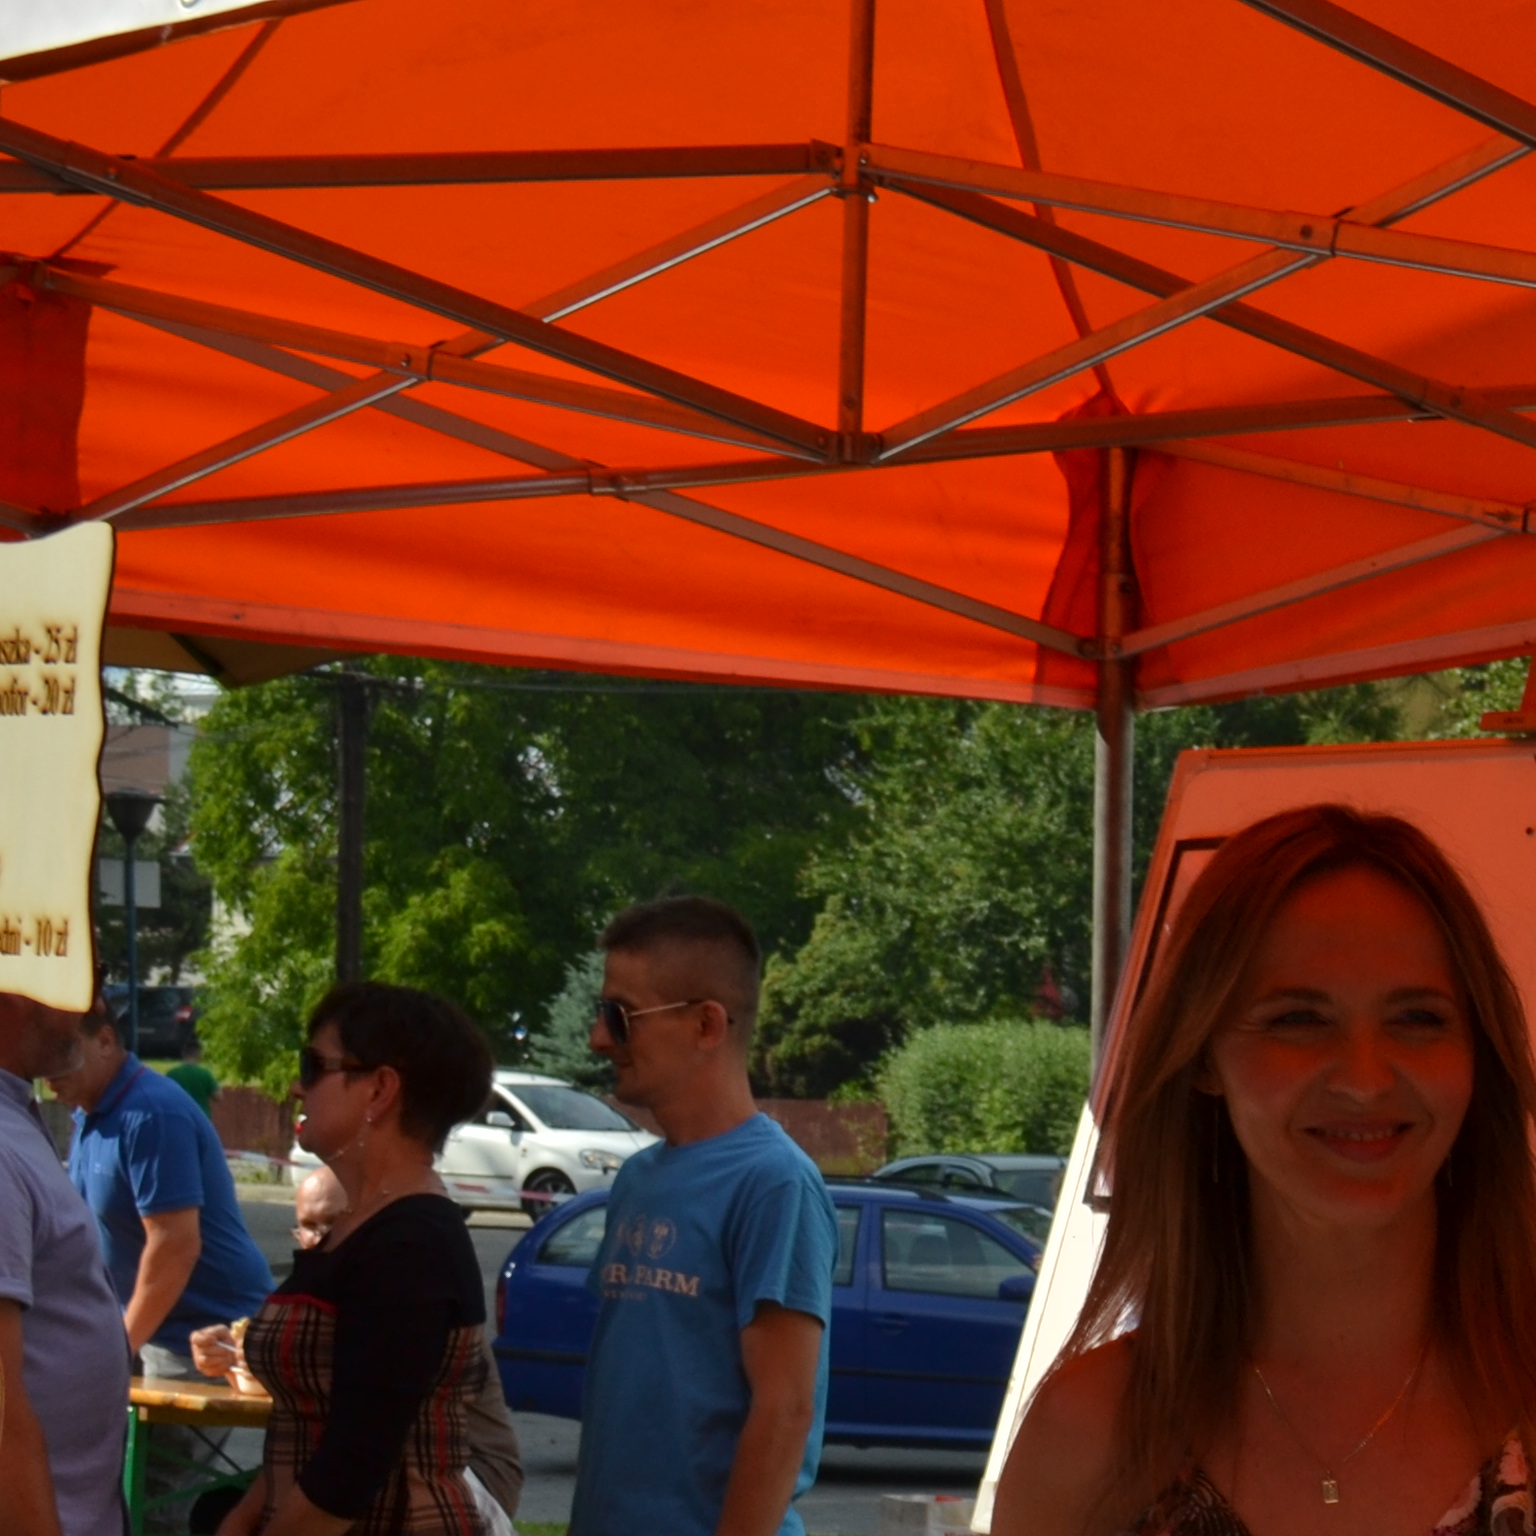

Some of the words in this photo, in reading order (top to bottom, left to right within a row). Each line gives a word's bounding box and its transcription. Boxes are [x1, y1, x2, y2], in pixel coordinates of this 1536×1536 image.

[44, 627, 61, 664] 25
[64, 626, 78, 664] zł
[41, 677, 60, 716] 20
[62, 676, 76, 715] zł
[36, 917, 53, 957] 10
[55, 918, 68, 957] zł
[634, 1264, 701, 1297] FARM
